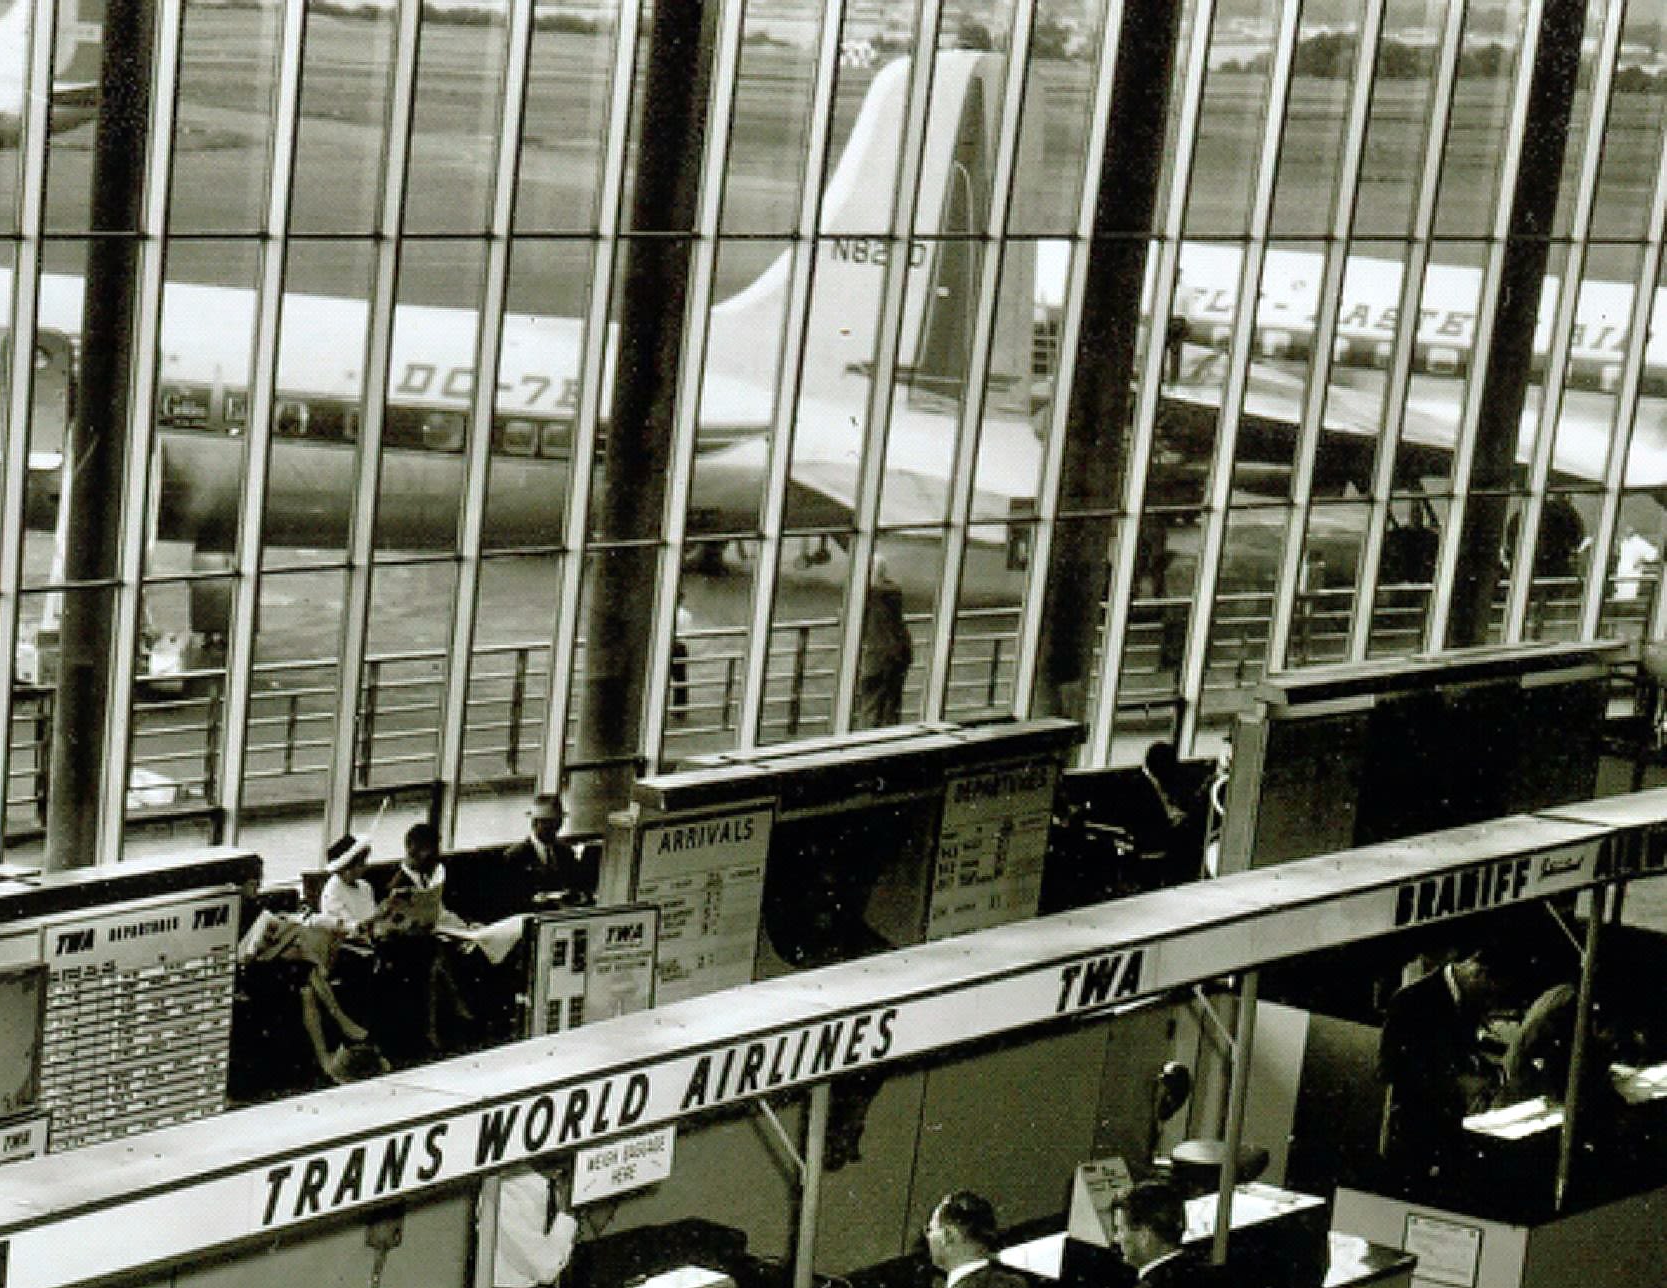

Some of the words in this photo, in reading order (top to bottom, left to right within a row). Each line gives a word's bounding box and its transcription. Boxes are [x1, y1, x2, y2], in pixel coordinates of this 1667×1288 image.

[657, 818, 754, 855] ARRIVALS
[55, 928, 95, 957] TWA
[192, 903, 230, 931] TWA
[605, 922, 644, 944] TWA
[1056, 949, 1144, 1013] TWA
[262, 1122, 447, 1226] TRANS
[475, 1072, 651, 1167] WORLD
[680, 1008, 898, 1110] AIRLINES
[587, 1150, 618, 1171] WEIGH
[622, 1135, 664, 1163] BAGGAGE
[611, 1163, 637, 1184] HERE
